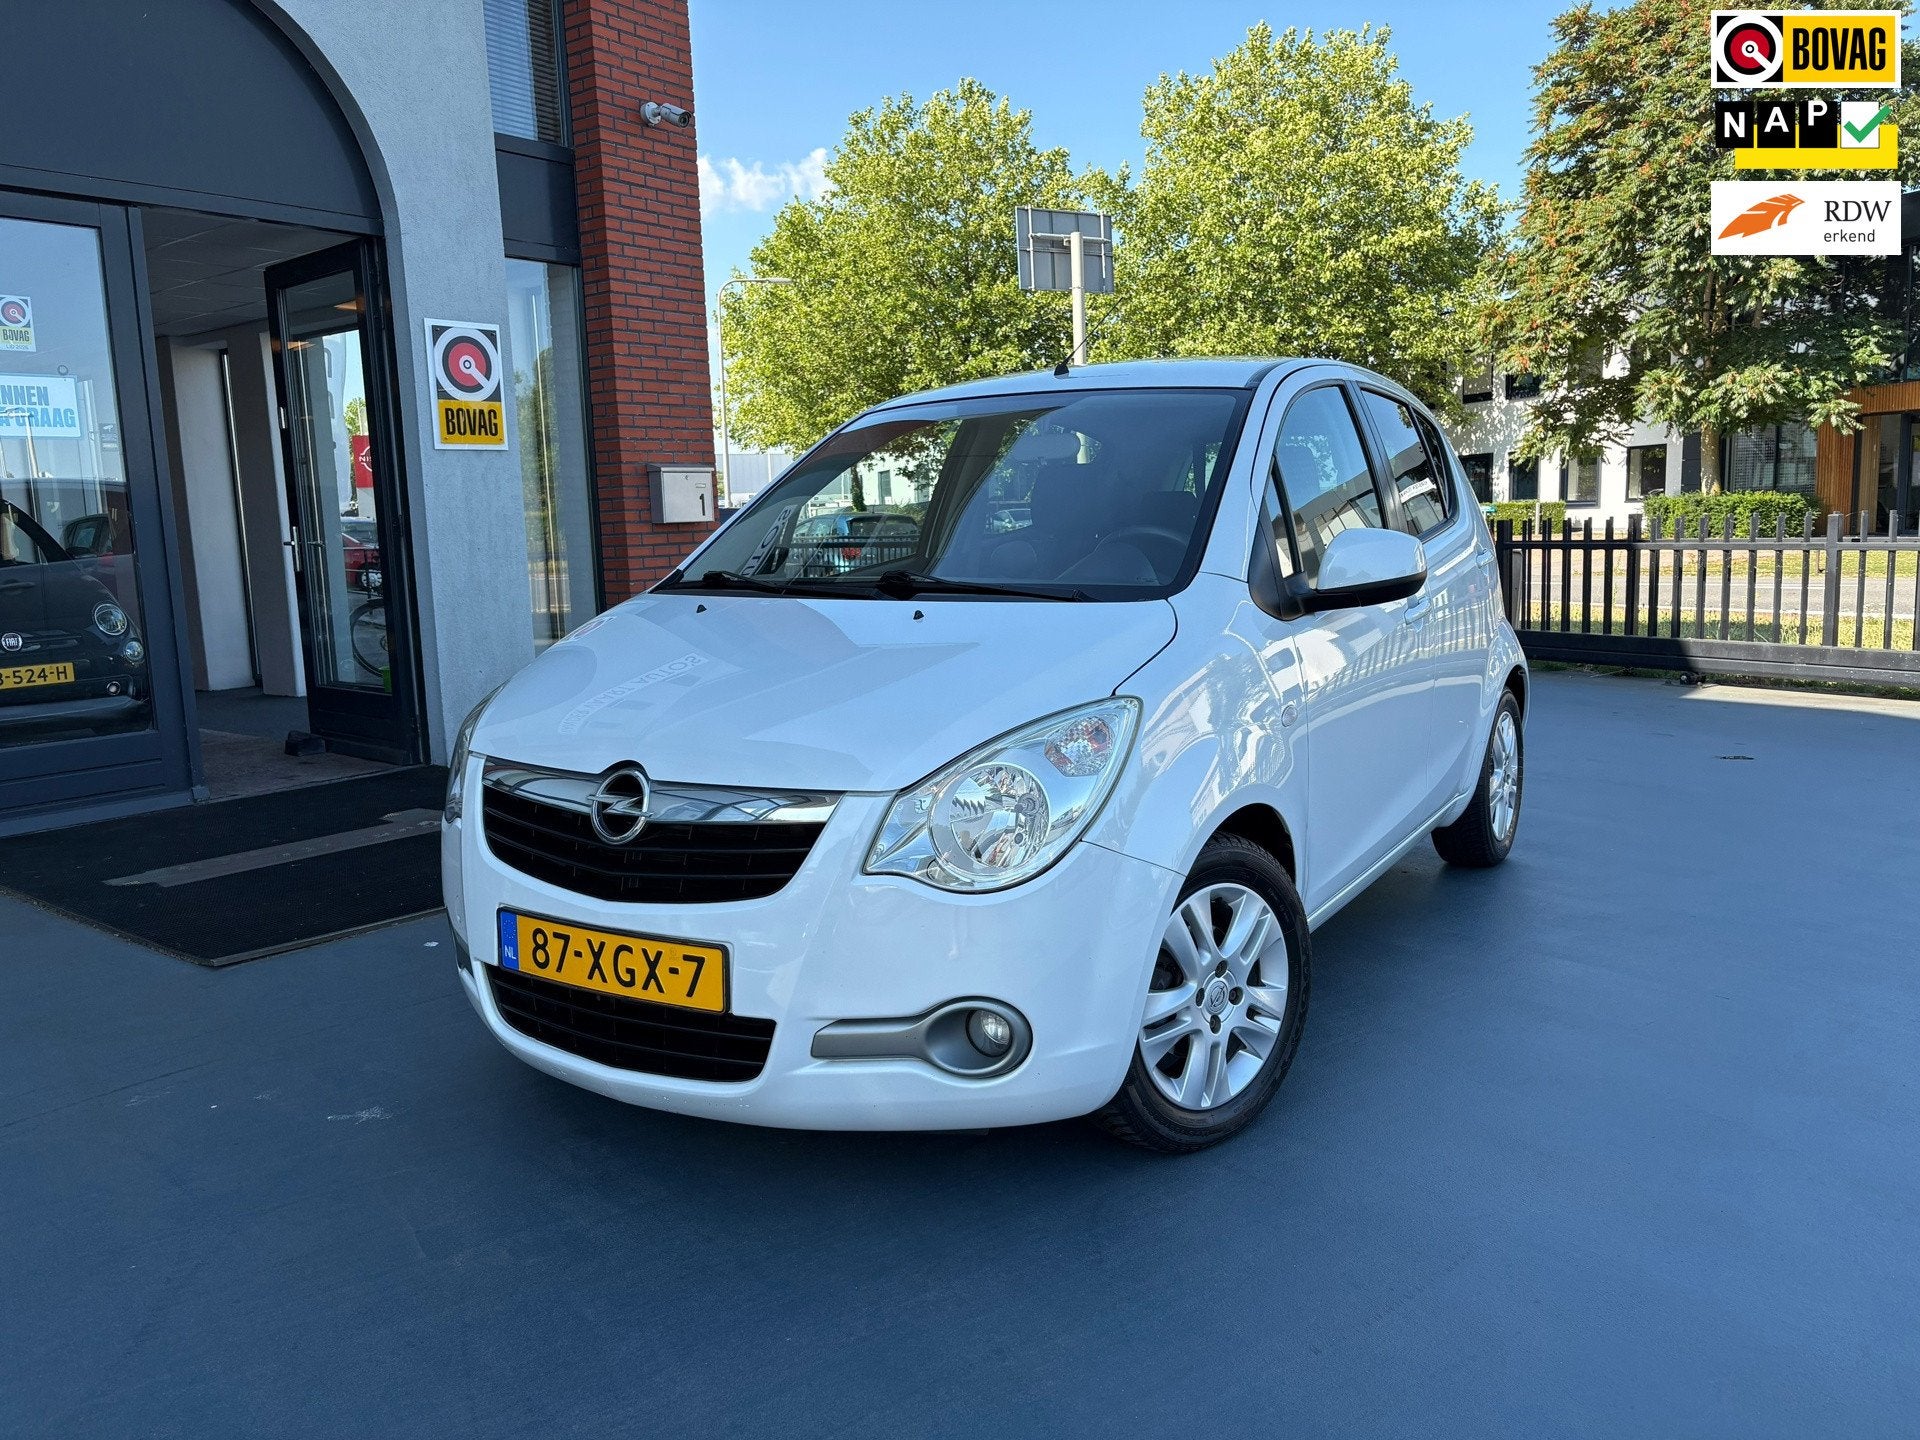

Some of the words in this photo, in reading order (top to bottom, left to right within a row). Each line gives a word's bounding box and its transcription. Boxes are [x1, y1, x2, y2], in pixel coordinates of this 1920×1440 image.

[3, 329, 30, 342] BOVAG
[0, 384, 50, 406] NNEN
[445, 407, 499, 437] BOVAG
[699, 493, 706, 516] 1
[5, 637, 18, 647] FIAT
[503, 944, 517, 960] NL
[531, 927, 706, 998] 87-XGX-7
